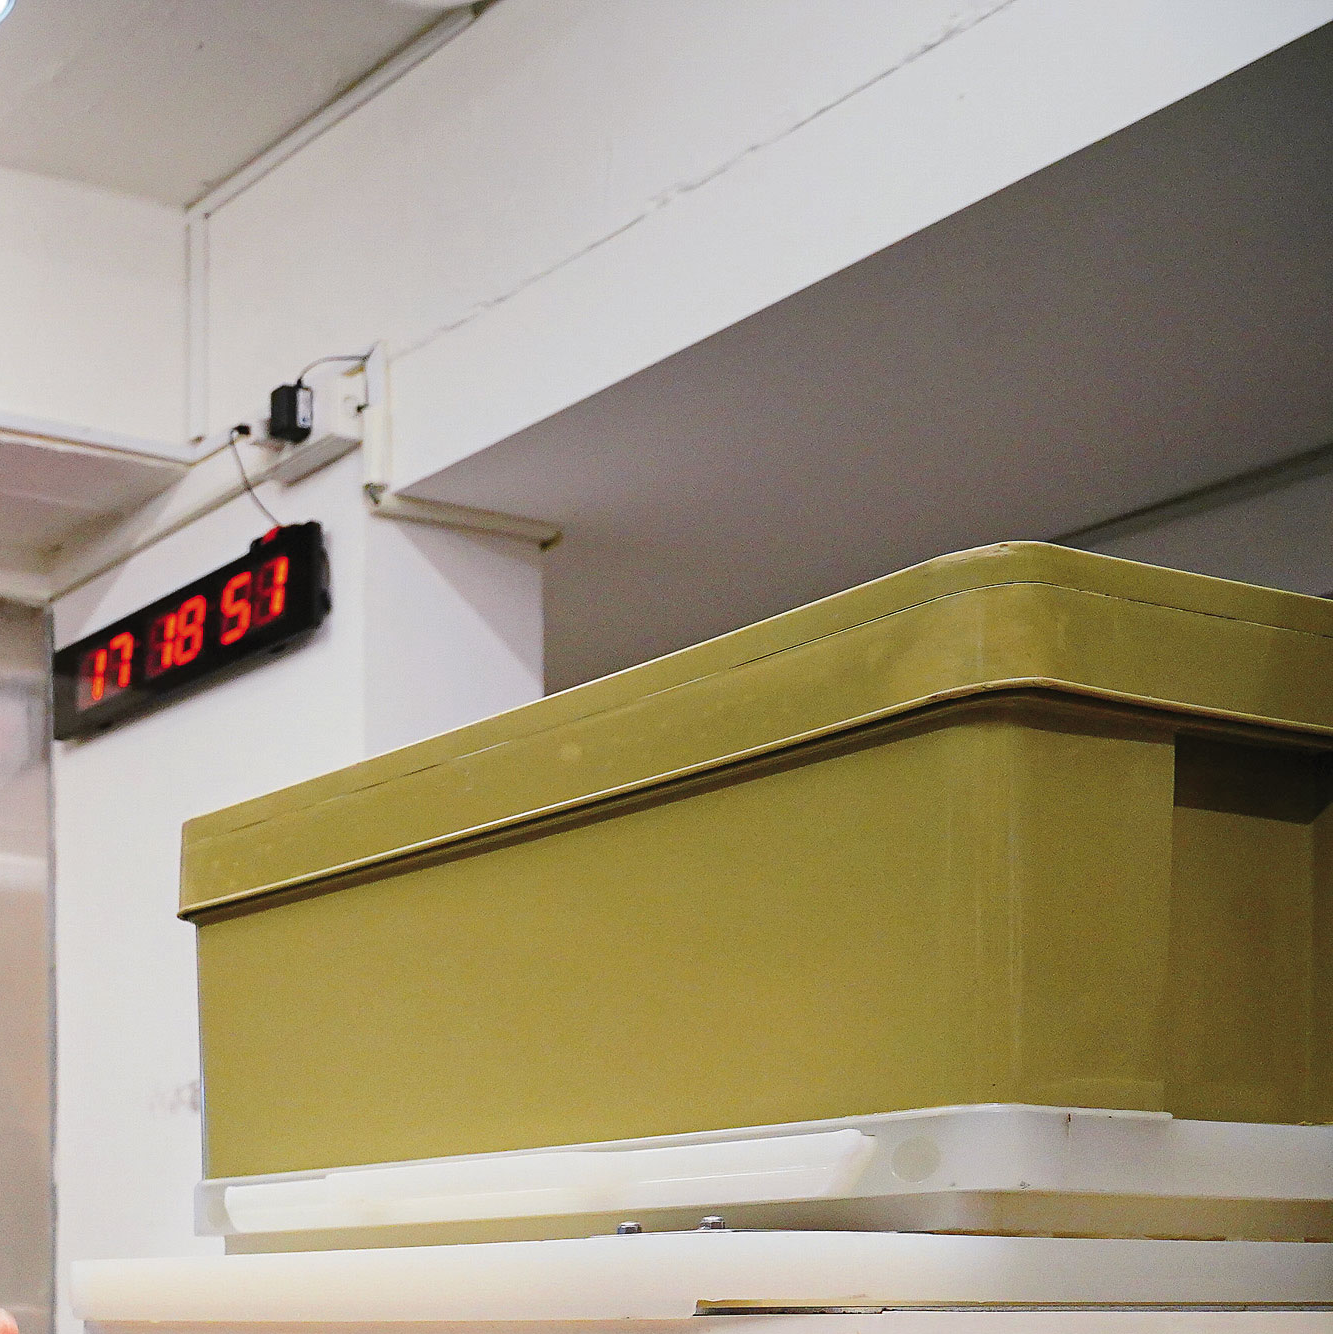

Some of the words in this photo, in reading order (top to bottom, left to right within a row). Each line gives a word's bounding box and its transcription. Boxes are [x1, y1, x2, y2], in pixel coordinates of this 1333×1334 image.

[91, 632, 134, 701] 17
[161, 595, 207, 668] 18
[220, 556, 289, 645] 51
